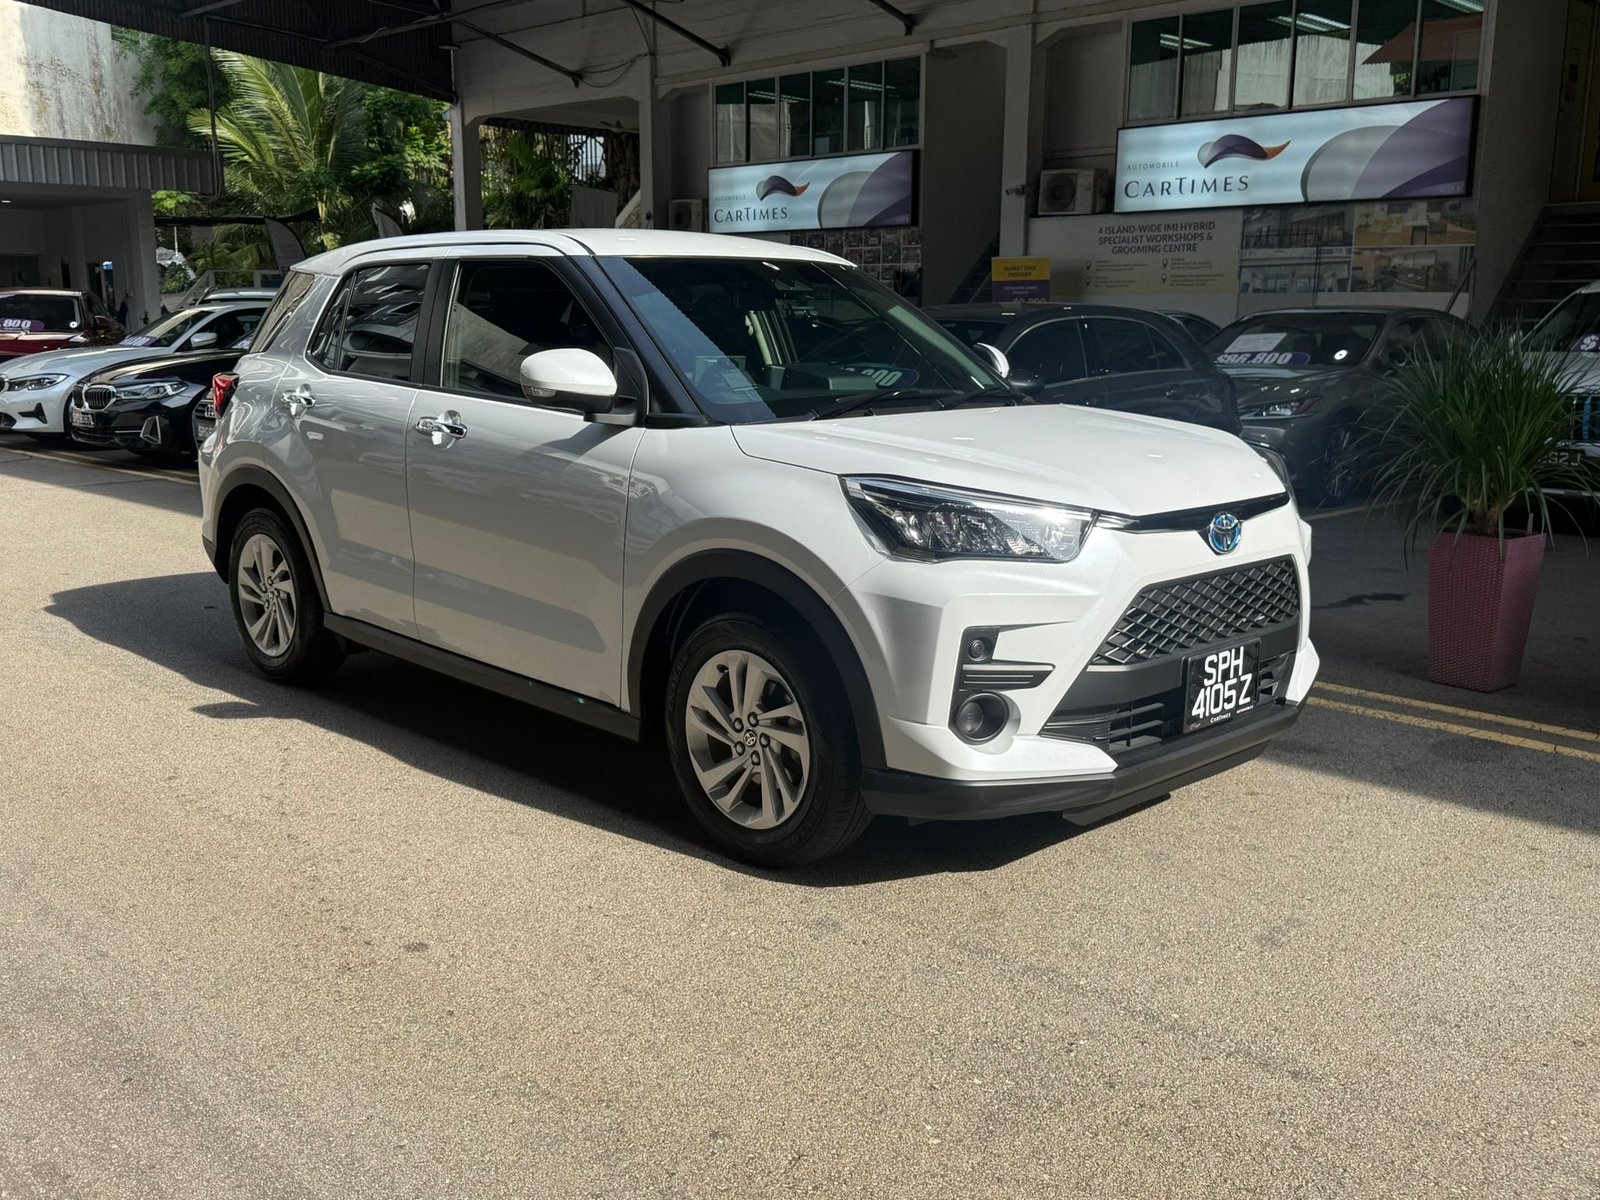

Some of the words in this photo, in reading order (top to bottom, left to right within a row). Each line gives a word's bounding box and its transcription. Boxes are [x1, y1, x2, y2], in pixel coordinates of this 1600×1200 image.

[1126, 161, 1179, 171] AUTOMOBILE
[1097, 226, 1103, 235] 4
[1104, 223, 1162, 235] ISLAND-WIDE
[1164, 222, 1178, 233] IMI
[1180, 220, 1216, 232] HYBRID
[1097, 234, 1144, 246] SPECIALIST
[1146, 232, 1205, 243] WORKSHOPS
[1206, 231, 1213, 241] &
[1111, 243, 1161, 255] GROOMING
[1162, 242, 1198, 253] CENTRE
[1203, 645, 1244, 687] SPH
[1192, 673, 1253, 719] 4105Z
